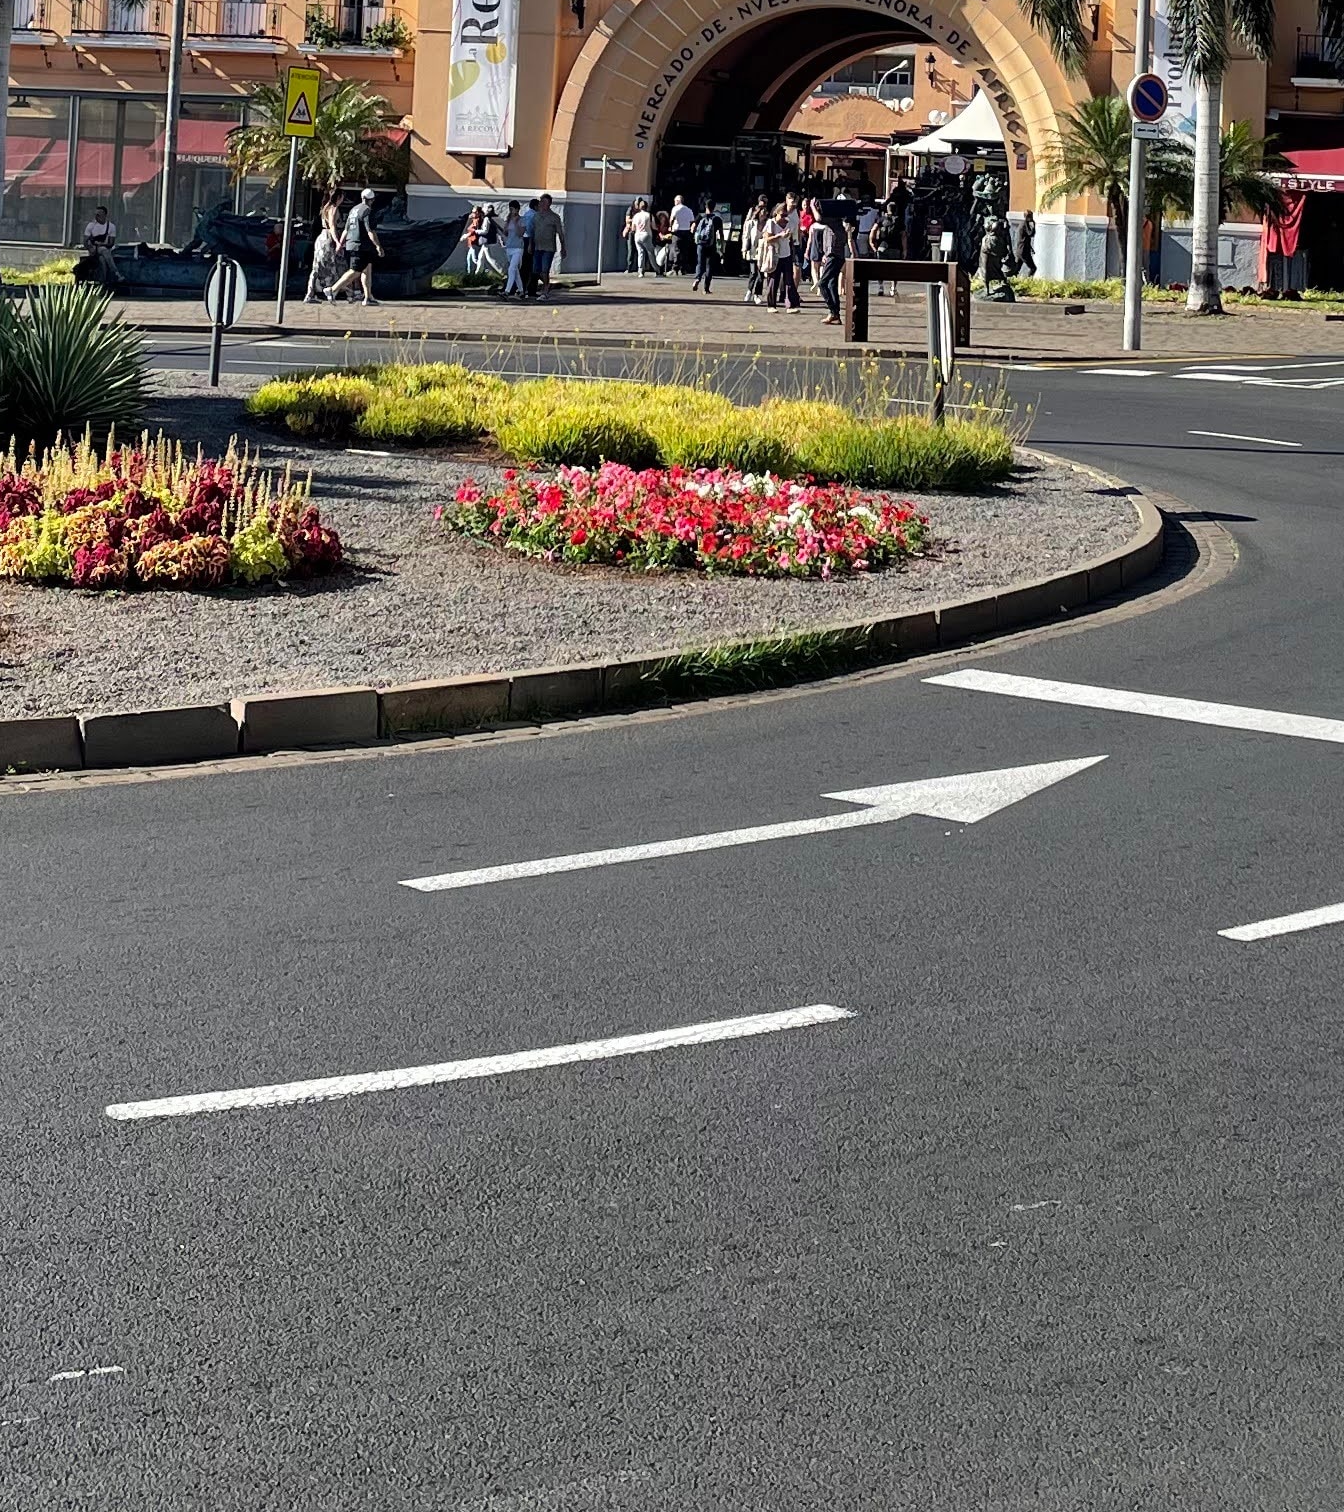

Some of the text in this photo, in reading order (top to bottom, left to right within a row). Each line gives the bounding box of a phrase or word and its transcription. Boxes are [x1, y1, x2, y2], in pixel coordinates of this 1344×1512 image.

[635, 47, 694, 141] MERCADO
[701, 19, 727, 43] DE
[946, 31, 971, 56] DE
[976, 67, 1031, 155] AFRICA
[467, 125, 500, 133] RECOVA
[176, 154, 228, 164] ELUQUERÍA
